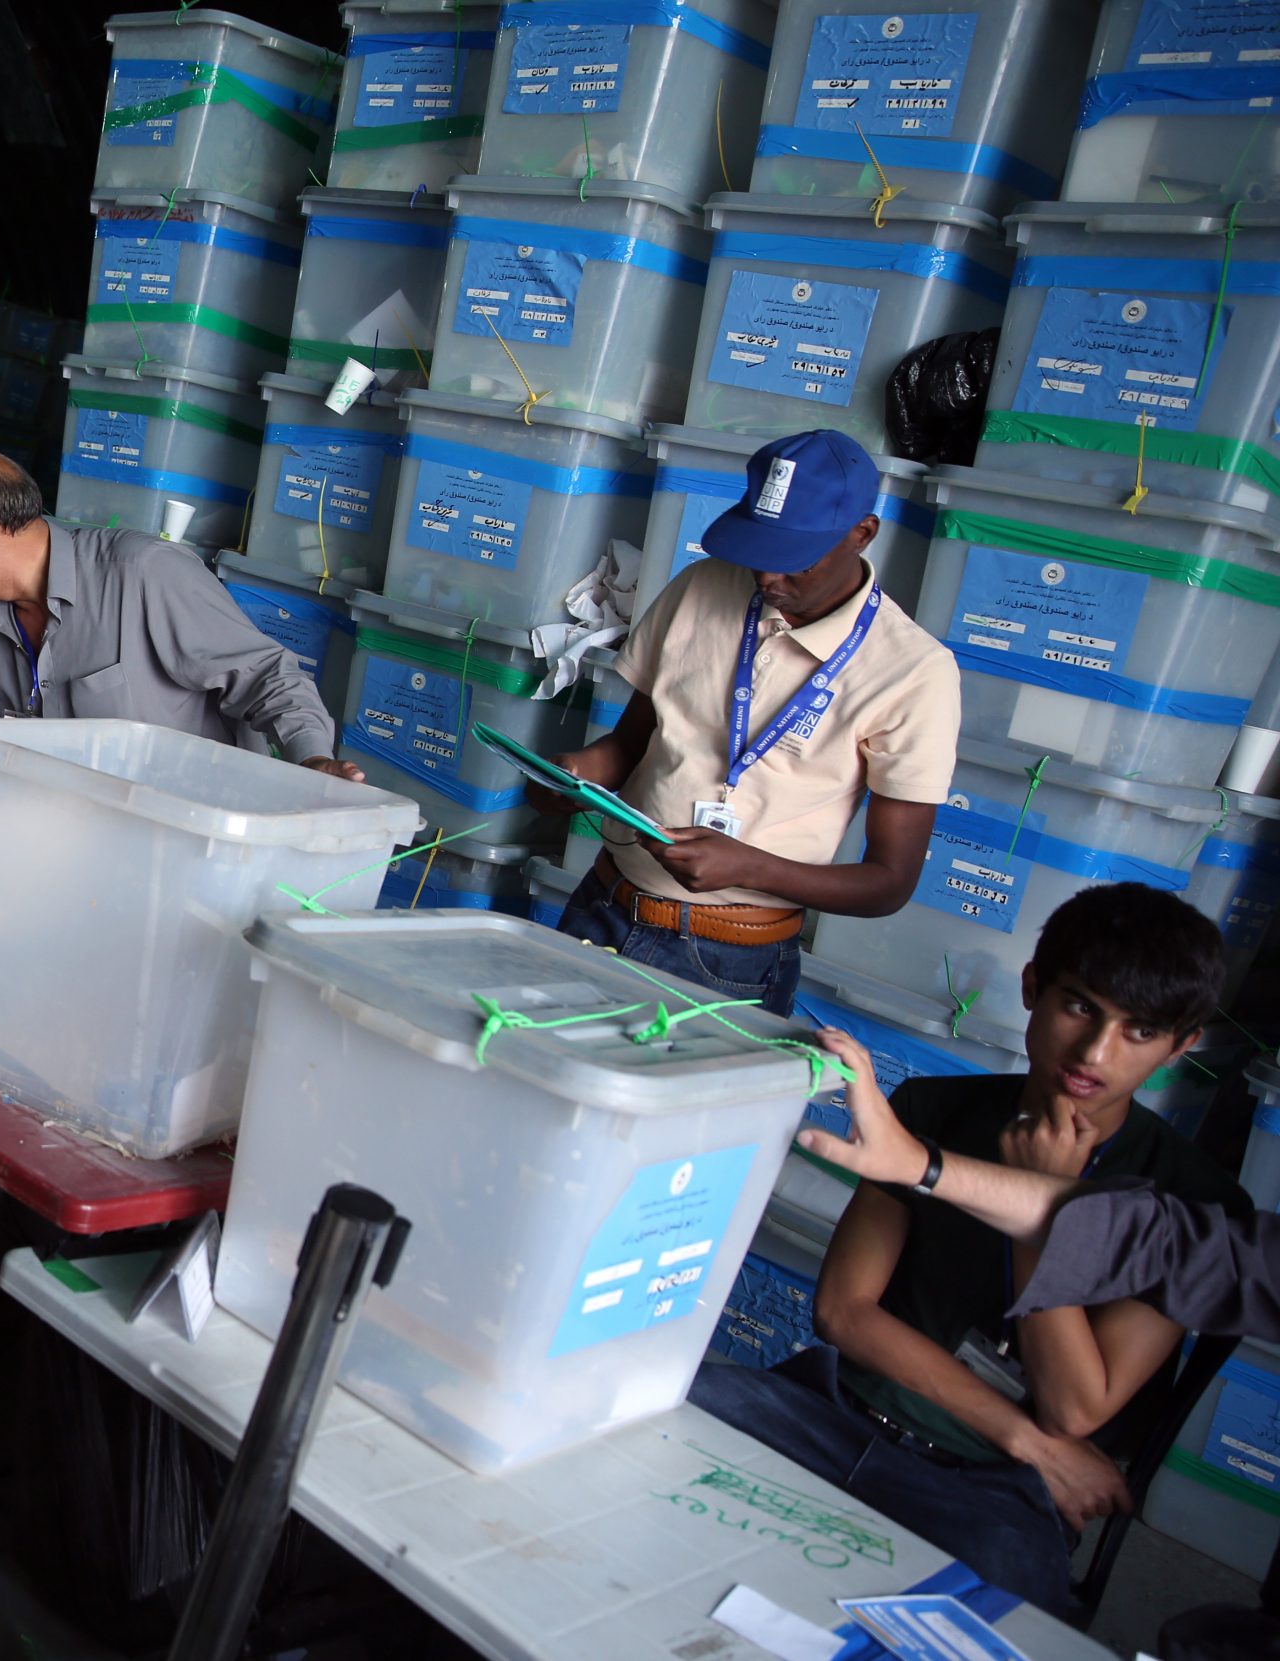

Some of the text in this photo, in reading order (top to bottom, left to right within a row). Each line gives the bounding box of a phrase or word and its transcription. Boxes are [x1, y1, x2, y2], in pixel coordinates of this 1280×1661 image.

[826, 625, 863, 673] UNITED NATIONS
[735, 705, 744, 730] UNITED
[757, 730, 777, 751] UNITED
[776, 705, 799, 729] NATIONS
